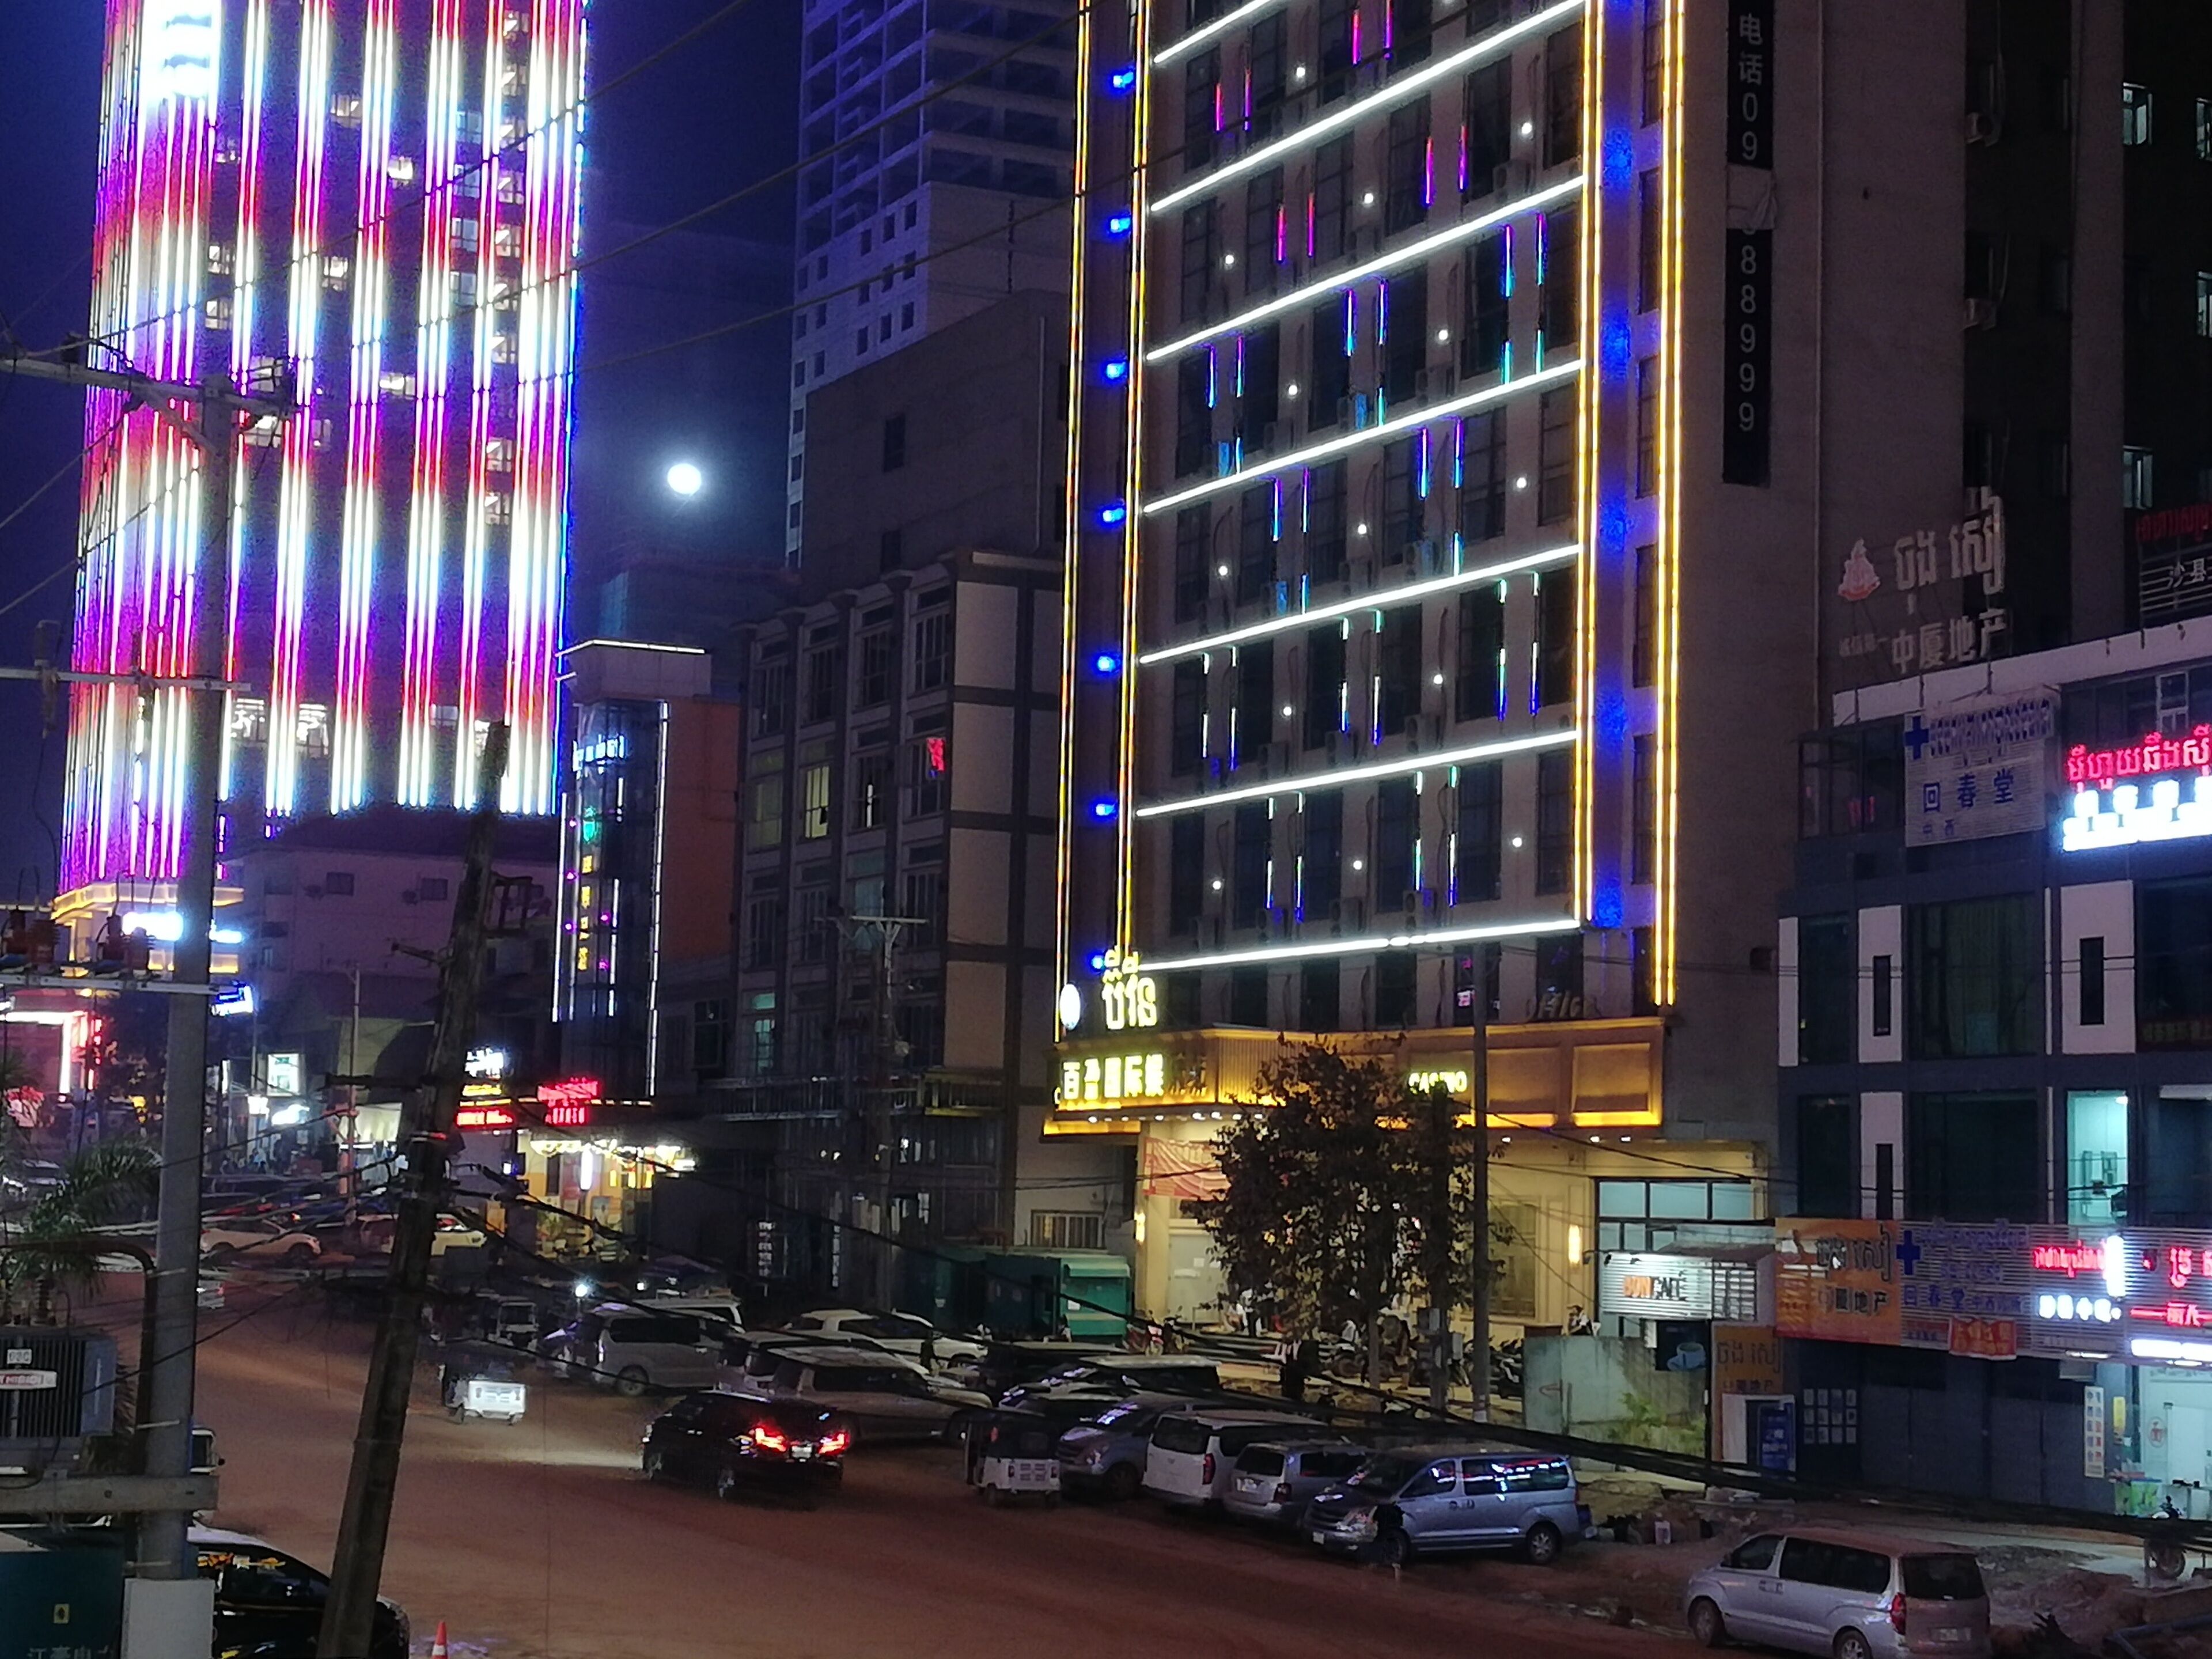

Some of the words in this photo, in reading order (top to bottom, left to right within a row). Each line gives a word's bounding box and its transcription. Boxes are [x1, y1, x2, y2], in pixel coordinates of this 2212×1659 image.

[1892, 608, 2007, 674] 中厦地产
[1923, 768, 2014, 813] 回春堂
